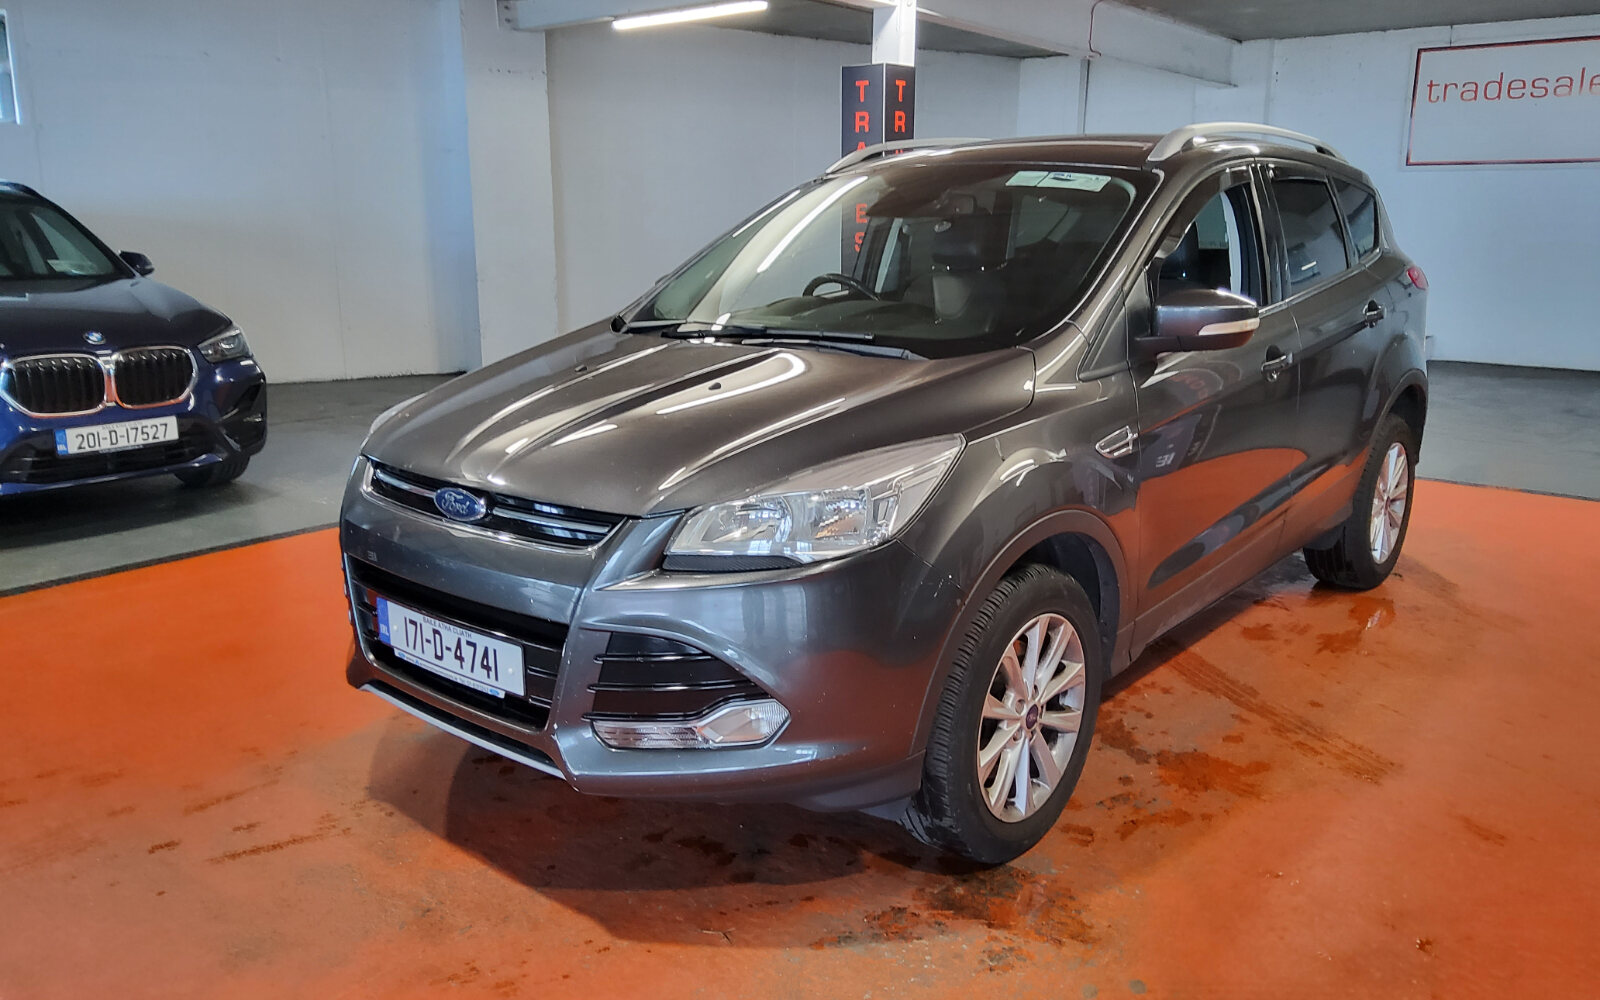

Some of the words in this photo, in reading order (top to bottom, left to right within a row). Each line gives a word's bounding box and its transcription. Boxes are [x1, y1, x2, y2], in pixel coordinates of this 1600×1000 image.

[75, 423, 168, 450] 201-D-17527
[441, 492, 470, 514] Ford
[404, 616, 499, 682] 171-D-4741
